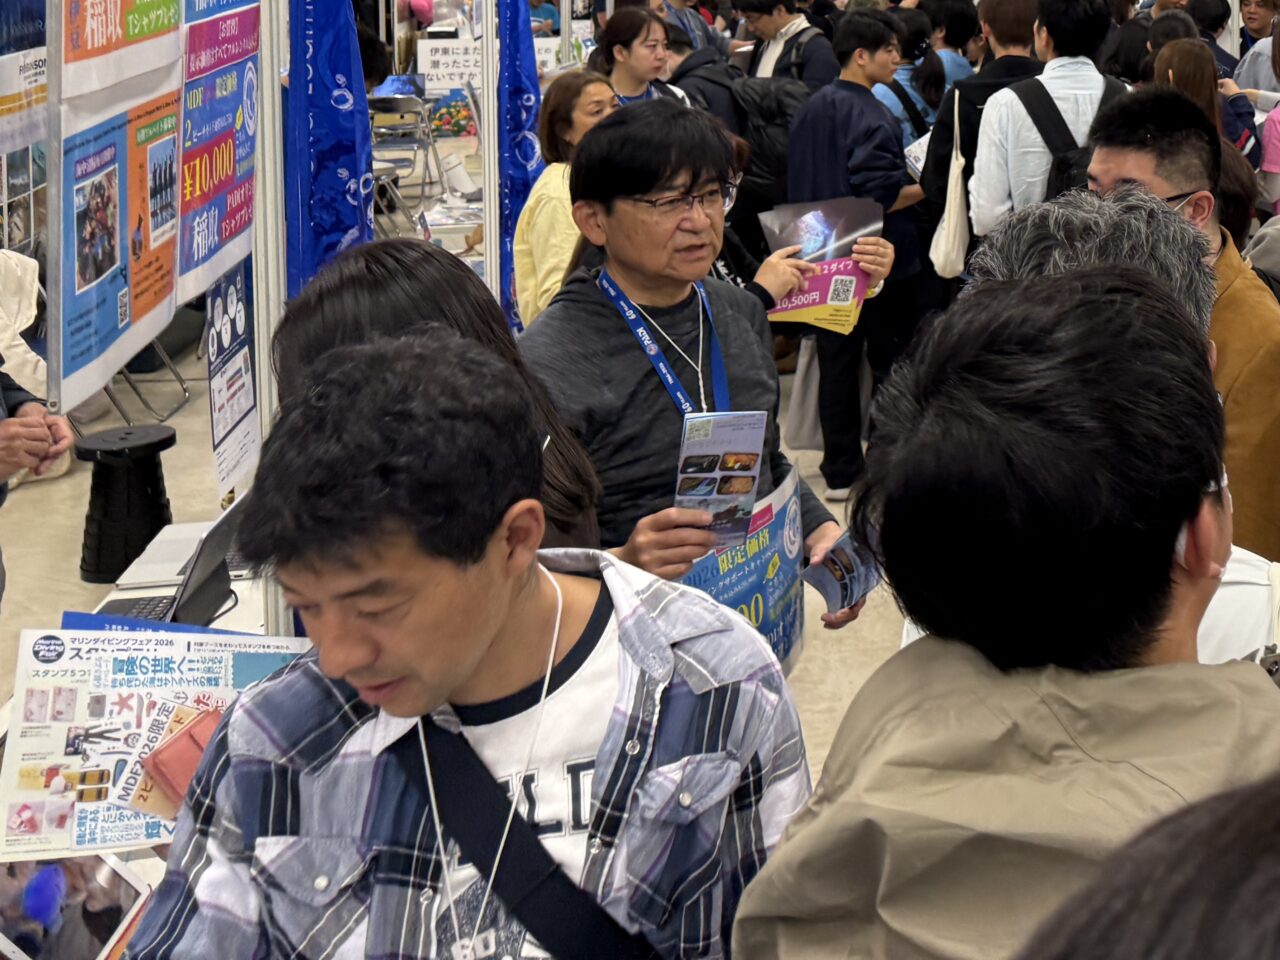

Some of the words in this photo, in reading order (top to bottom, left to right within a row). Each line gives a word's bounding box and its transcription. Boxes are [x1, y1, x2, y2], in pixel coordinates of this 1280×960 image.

[184, 139, 234, 201] ¥10,000
[192, 206, 218, 262] 稲取
[776, 291, 820, 309] 10,500円
[636, 326, 653, 346] PADI
[69, 637, 152, 647] マリンダイビングフェア
[154, 639, 175, 647] 2026
